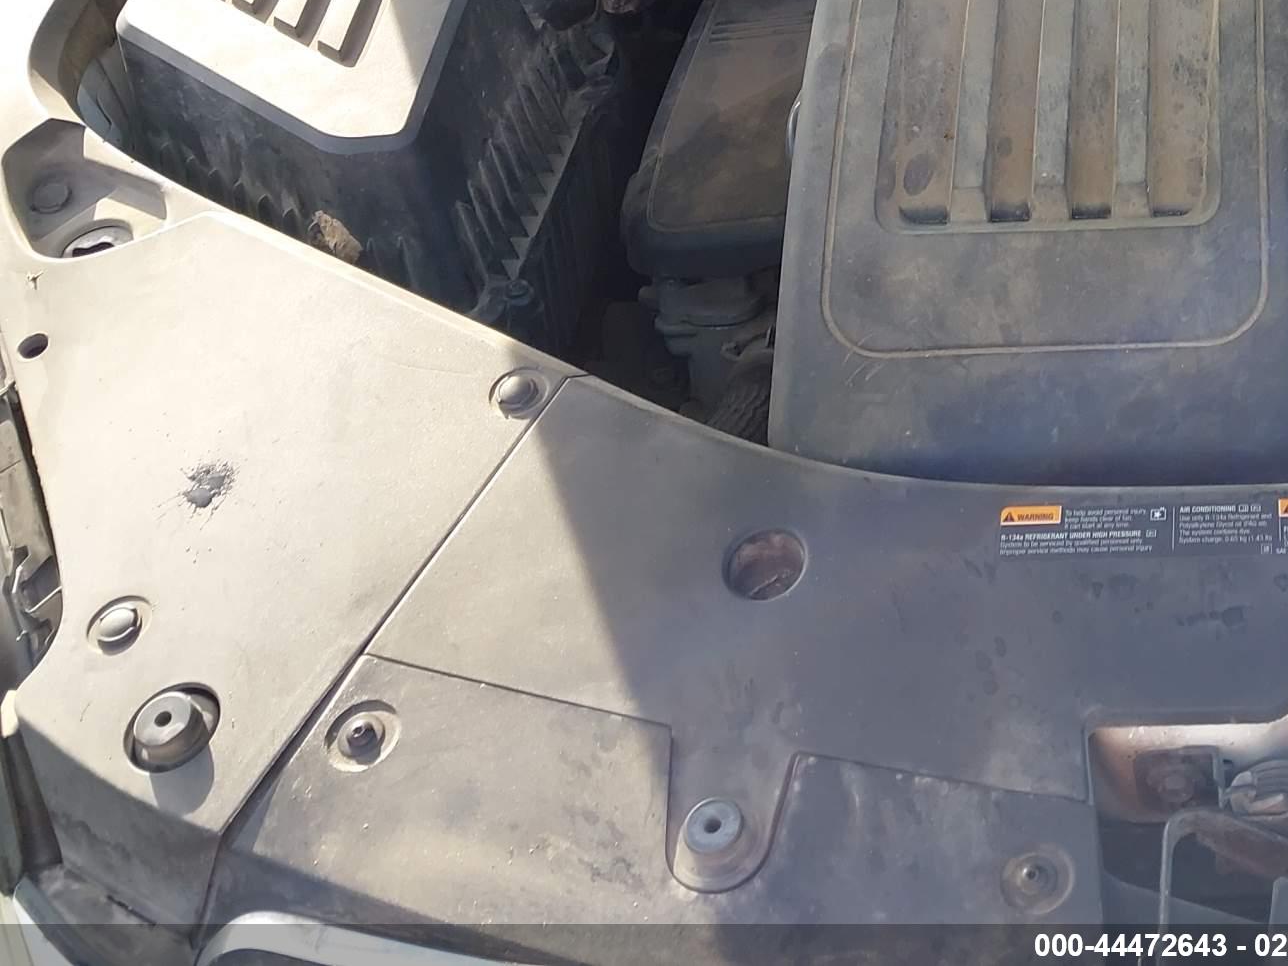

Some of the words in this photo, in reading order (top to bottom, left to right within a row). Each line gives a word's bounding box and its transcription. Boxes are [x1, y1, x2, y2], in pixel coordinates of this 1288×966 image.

[1180, 506, 1191, 514] AIR
[1192, 505, 1236, 513] CONDITIONING
[1017, 513, 1054, 521] WARNING
[1025, 533, 1068, 541] REFRIGERANT
[1092, 531, 1108, 539] HIGH
[1109, 530, 1142, 538] PRESSURE
